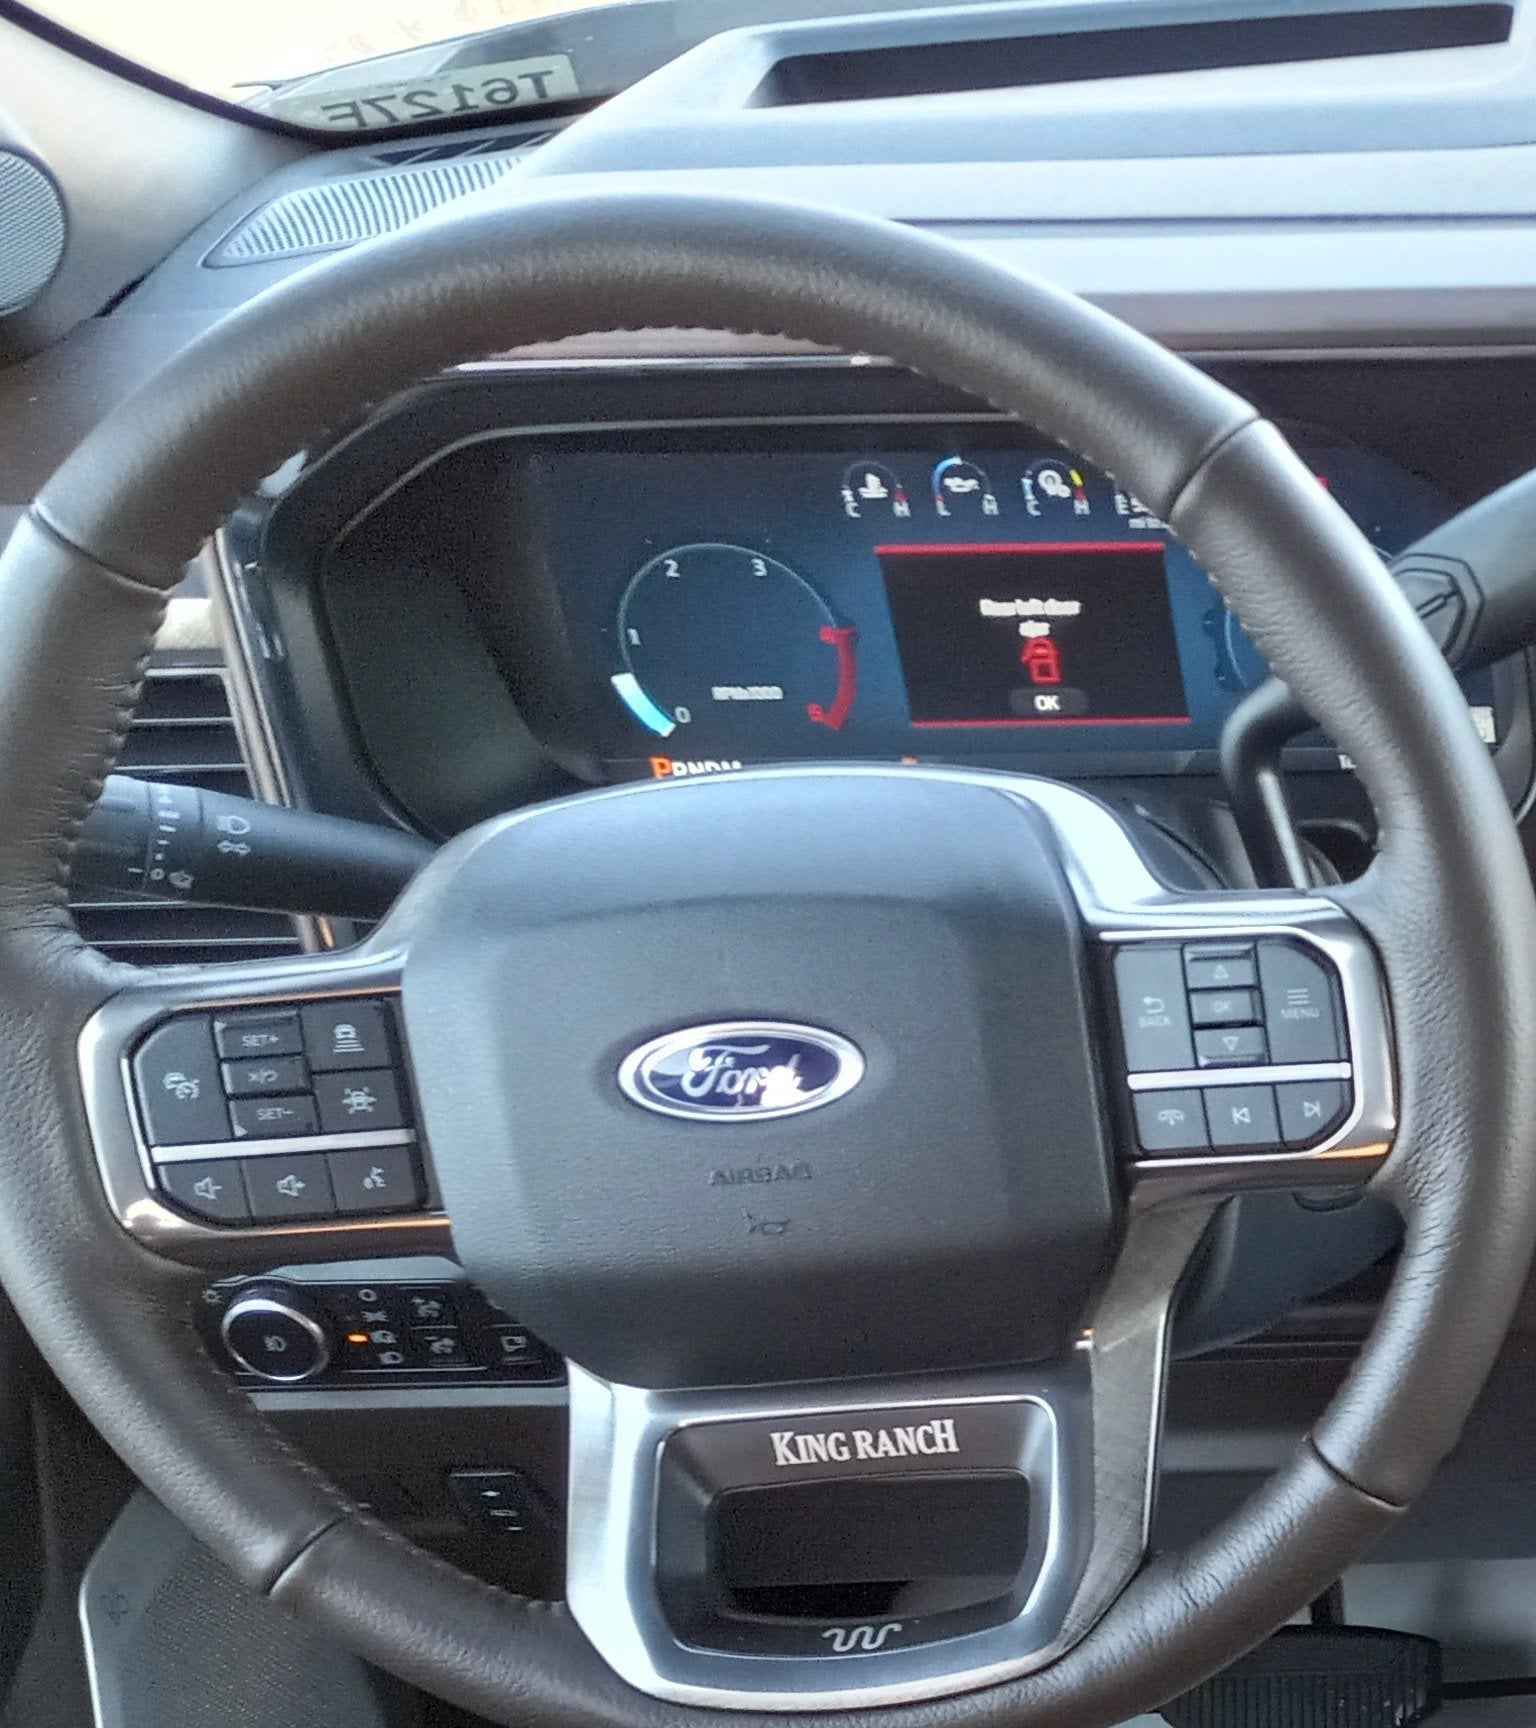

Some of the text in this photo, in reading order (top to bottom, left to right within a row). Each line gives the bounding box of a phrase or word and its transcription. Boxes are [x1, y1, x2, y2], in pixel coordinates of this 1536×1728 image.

[664, 560, 680, 577] 2
[752, 559, 767, 576] 3
[627, 628, 641, 645] 1
[1034, 694, 1061, 711] OK
[675, 706, 691, 723] 0
[1279, 1008, 1320, 1020] MENU
[769, 1418, 960, 1467] KING RANCH
